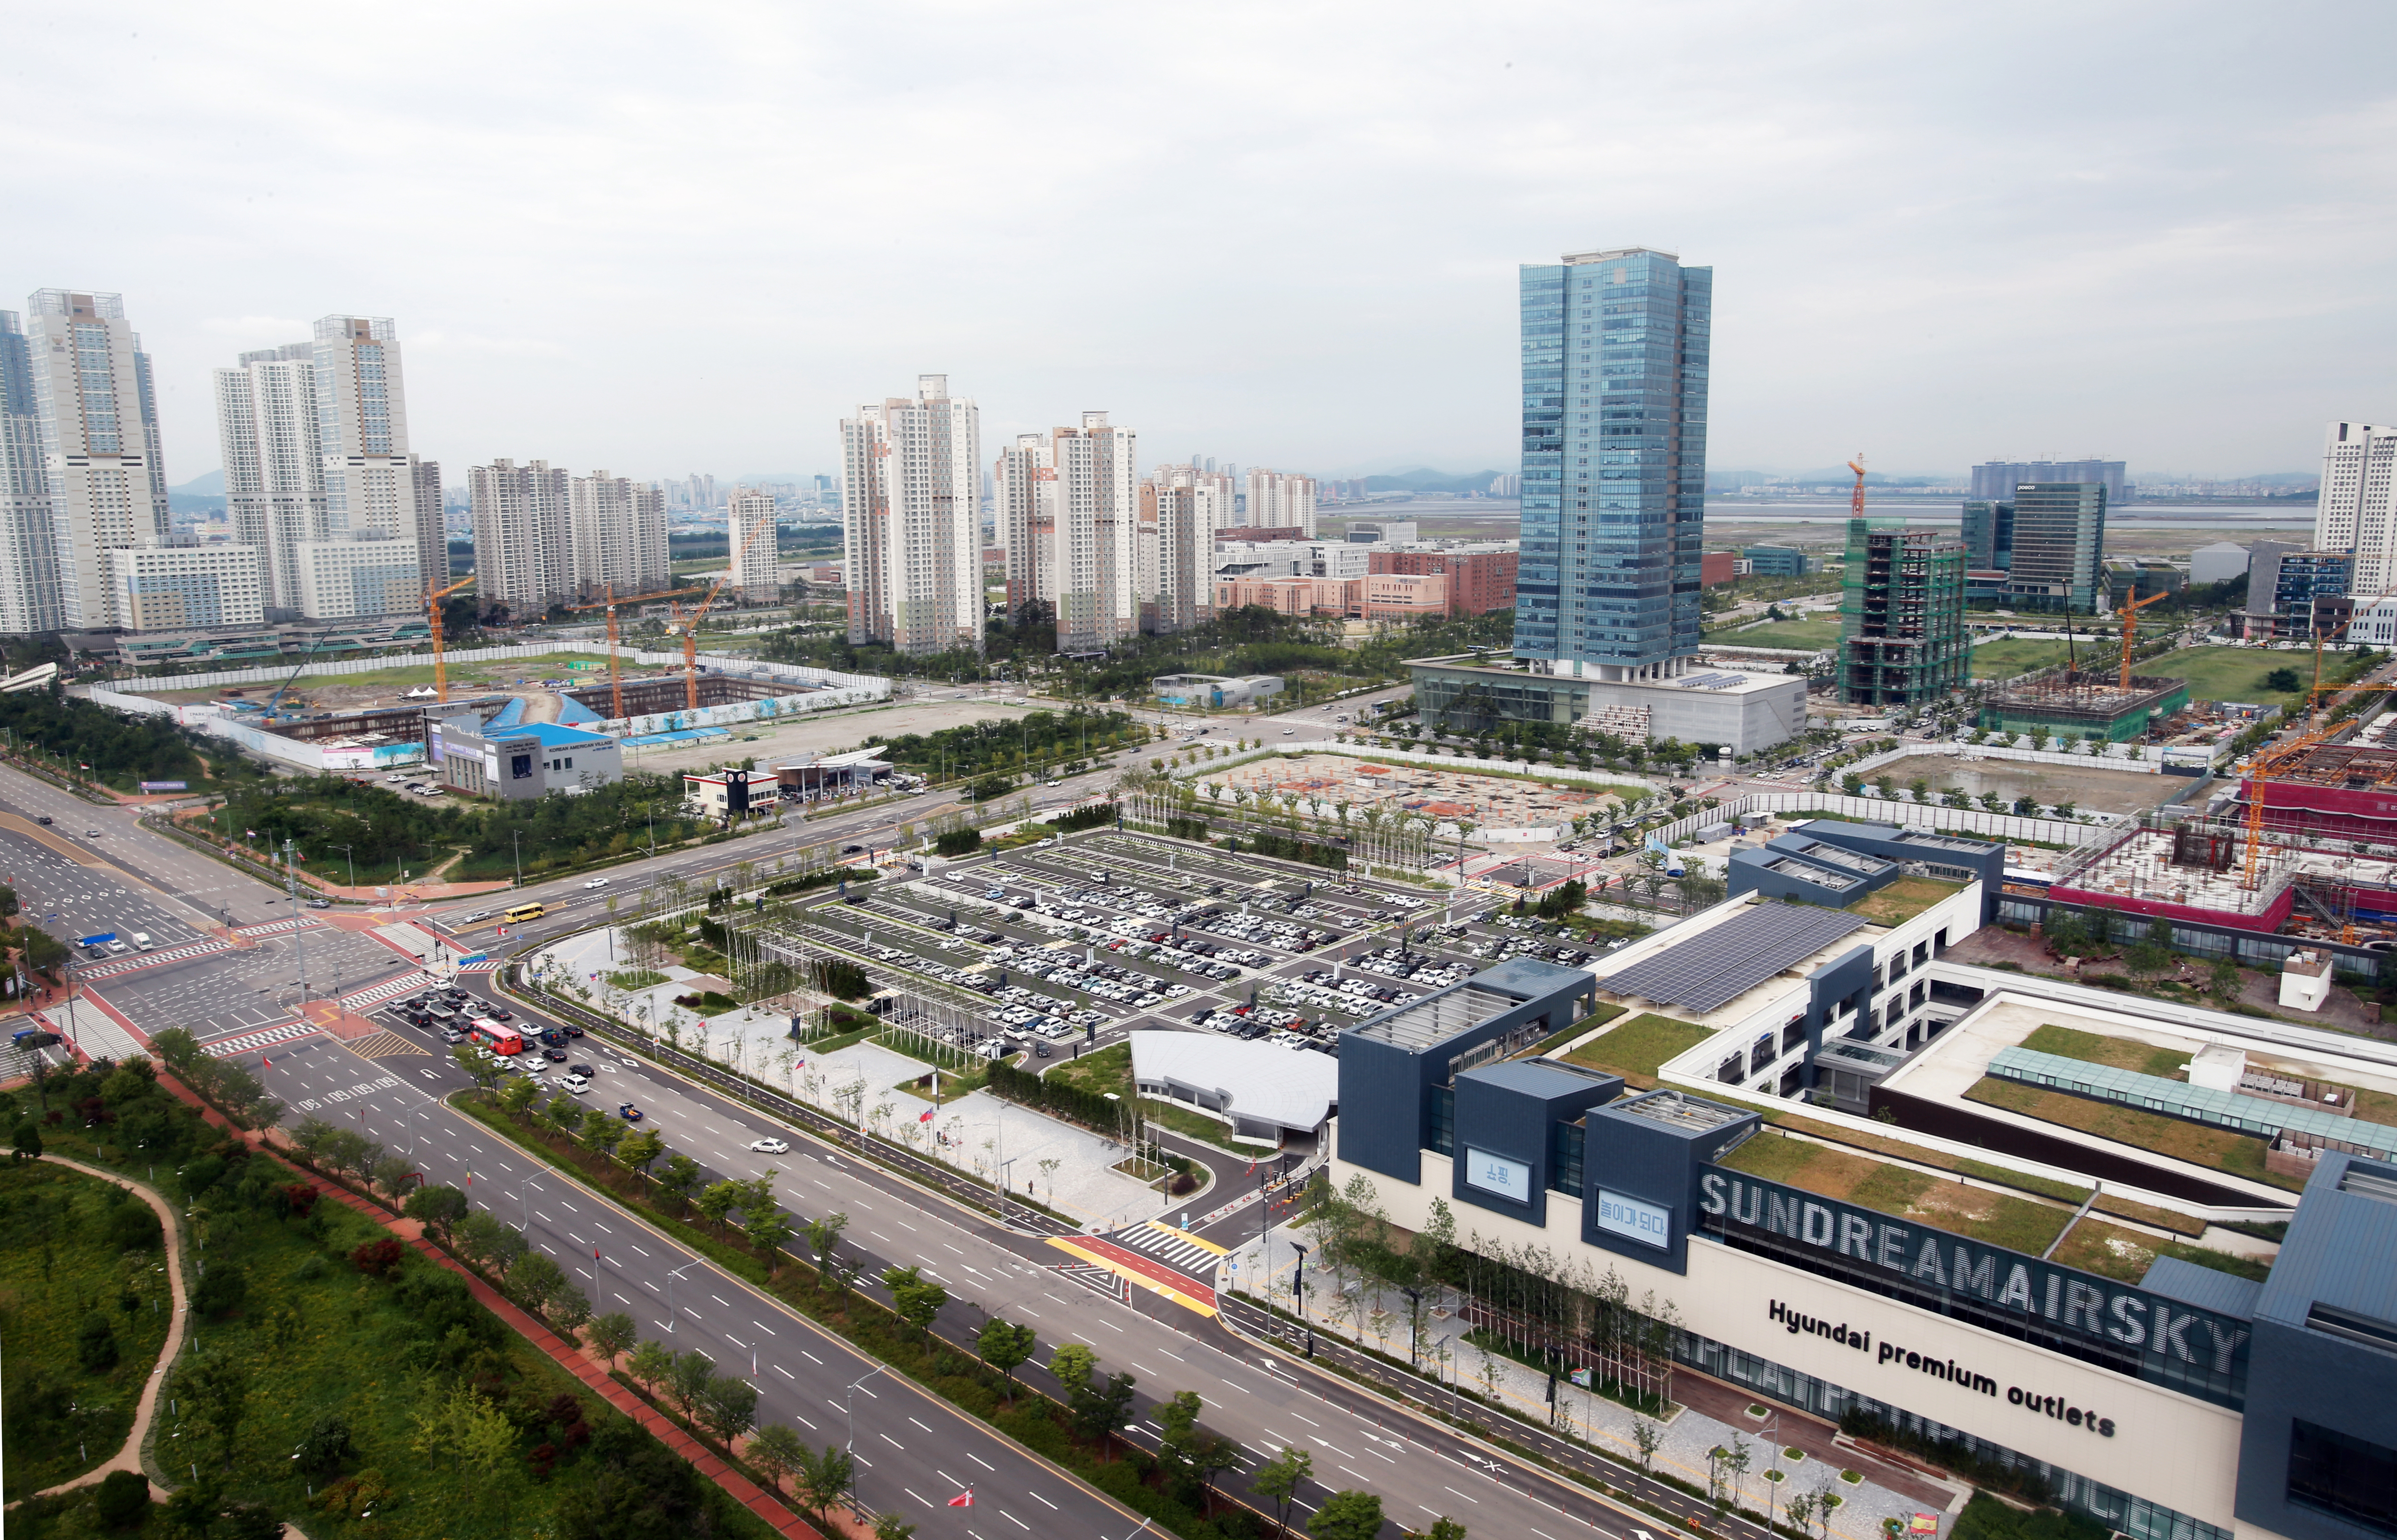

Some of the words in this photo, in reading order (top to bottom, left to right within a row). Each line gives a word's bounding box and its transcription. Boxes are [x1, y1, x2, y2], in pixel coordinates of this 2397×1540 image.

[1769, 1298, 1870, 1352] Hyundai
[1878, 1340, 1997, 1397] premium
[2007, 1386, 2116, 1438] outlets
